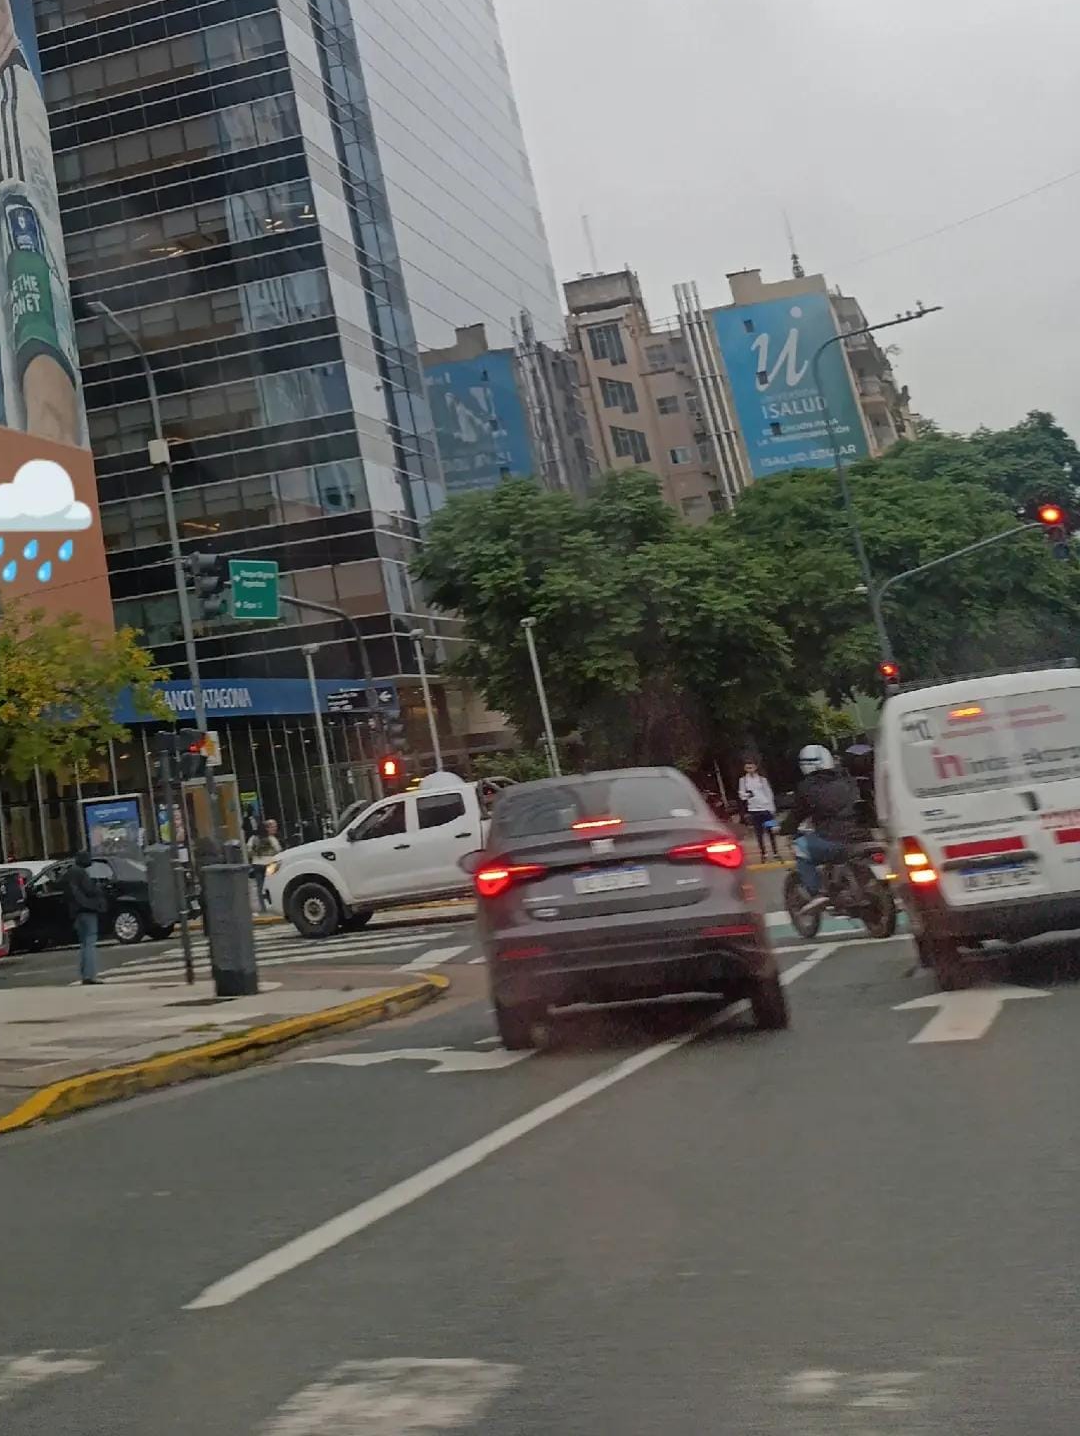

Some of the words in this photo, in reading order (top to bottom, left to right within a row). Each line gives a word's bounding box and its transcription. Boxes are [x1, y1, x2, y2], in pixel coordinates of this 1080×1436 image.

[761, 395, 826, 420] ISALUD
[163, 689, 196, 711] ANCO
[201, 686, 253, 709] ATAGONIA
